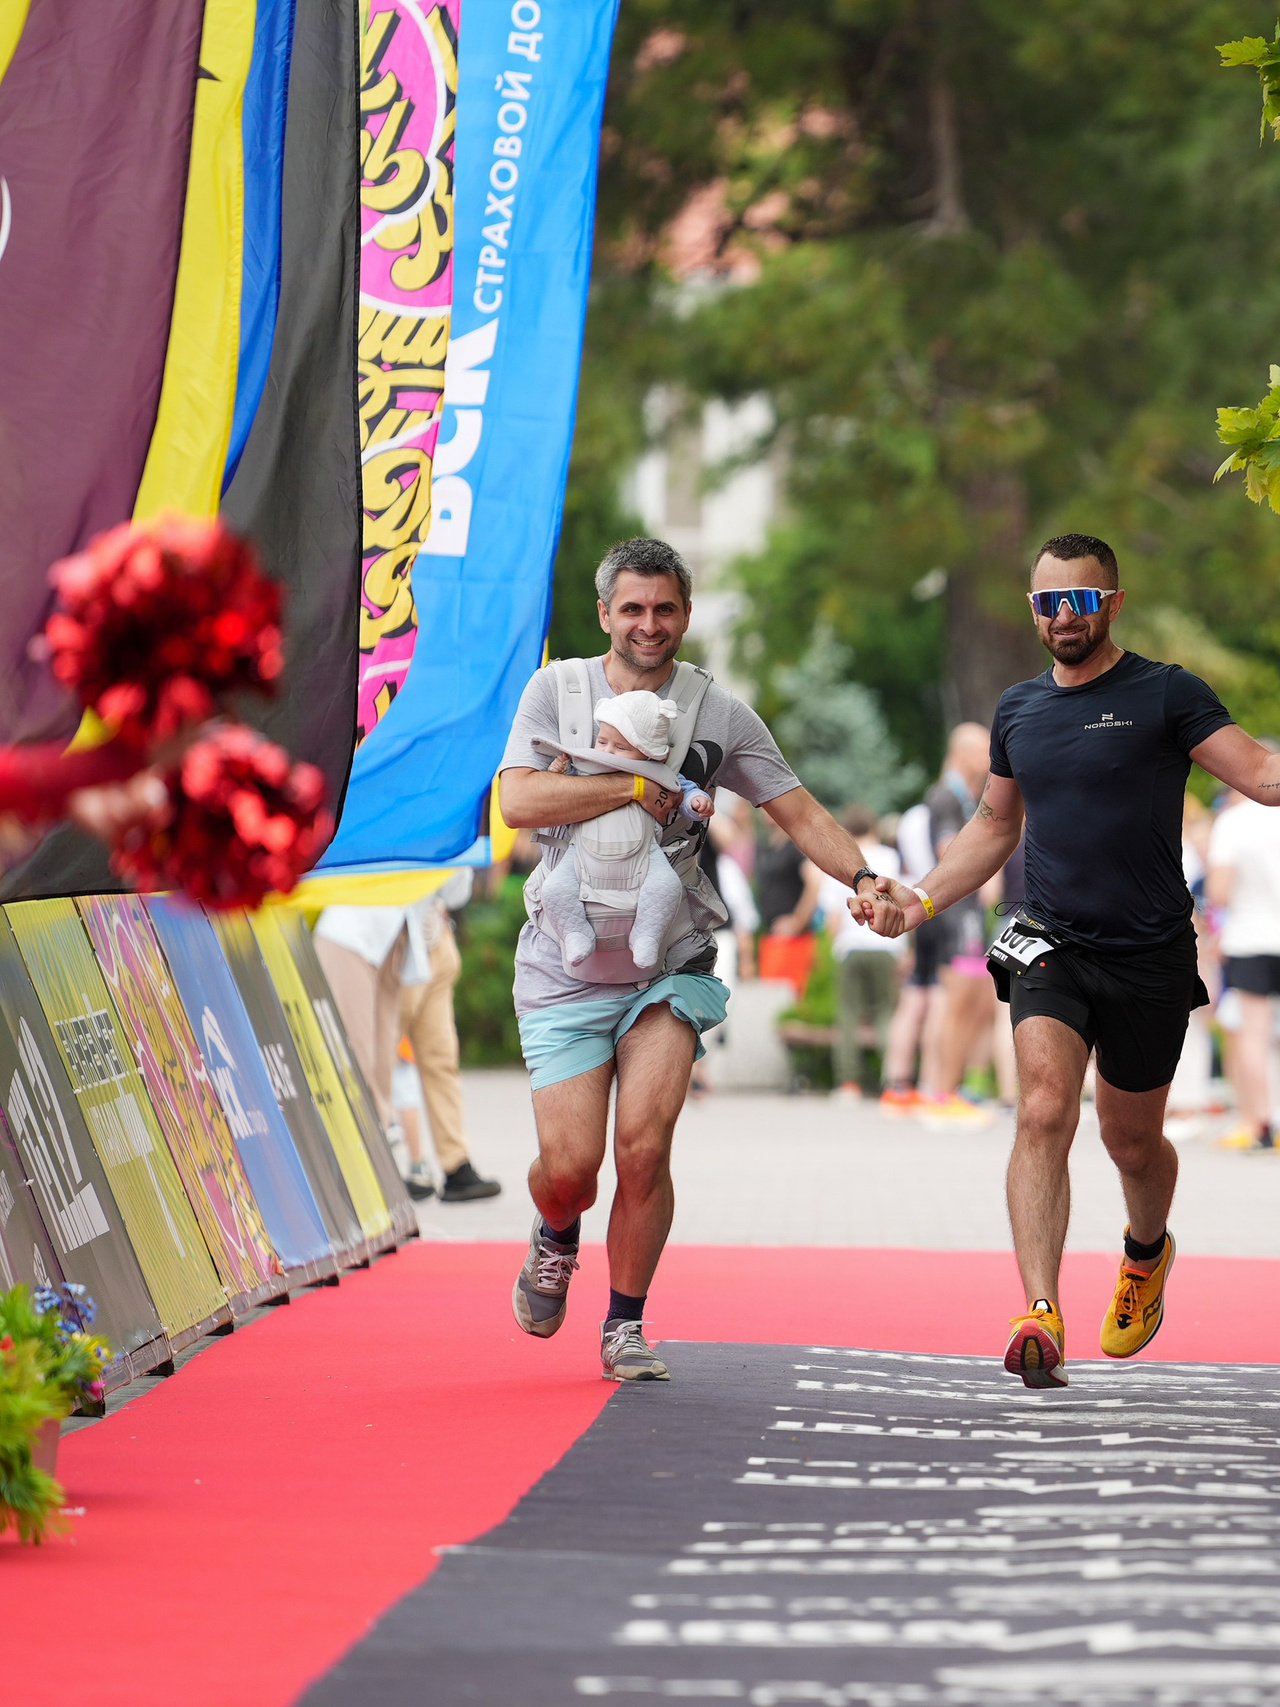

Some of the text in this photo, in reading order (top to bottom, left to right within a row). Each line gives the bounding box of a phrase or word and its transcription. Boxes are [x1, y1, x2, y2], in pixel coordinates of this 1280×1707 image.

[473, 70, 533, 314] СТРАХОВОЙ
[1084, 720, 1133, 730] NORDSKI
[775, 1421, 1042, 1439] IRON
